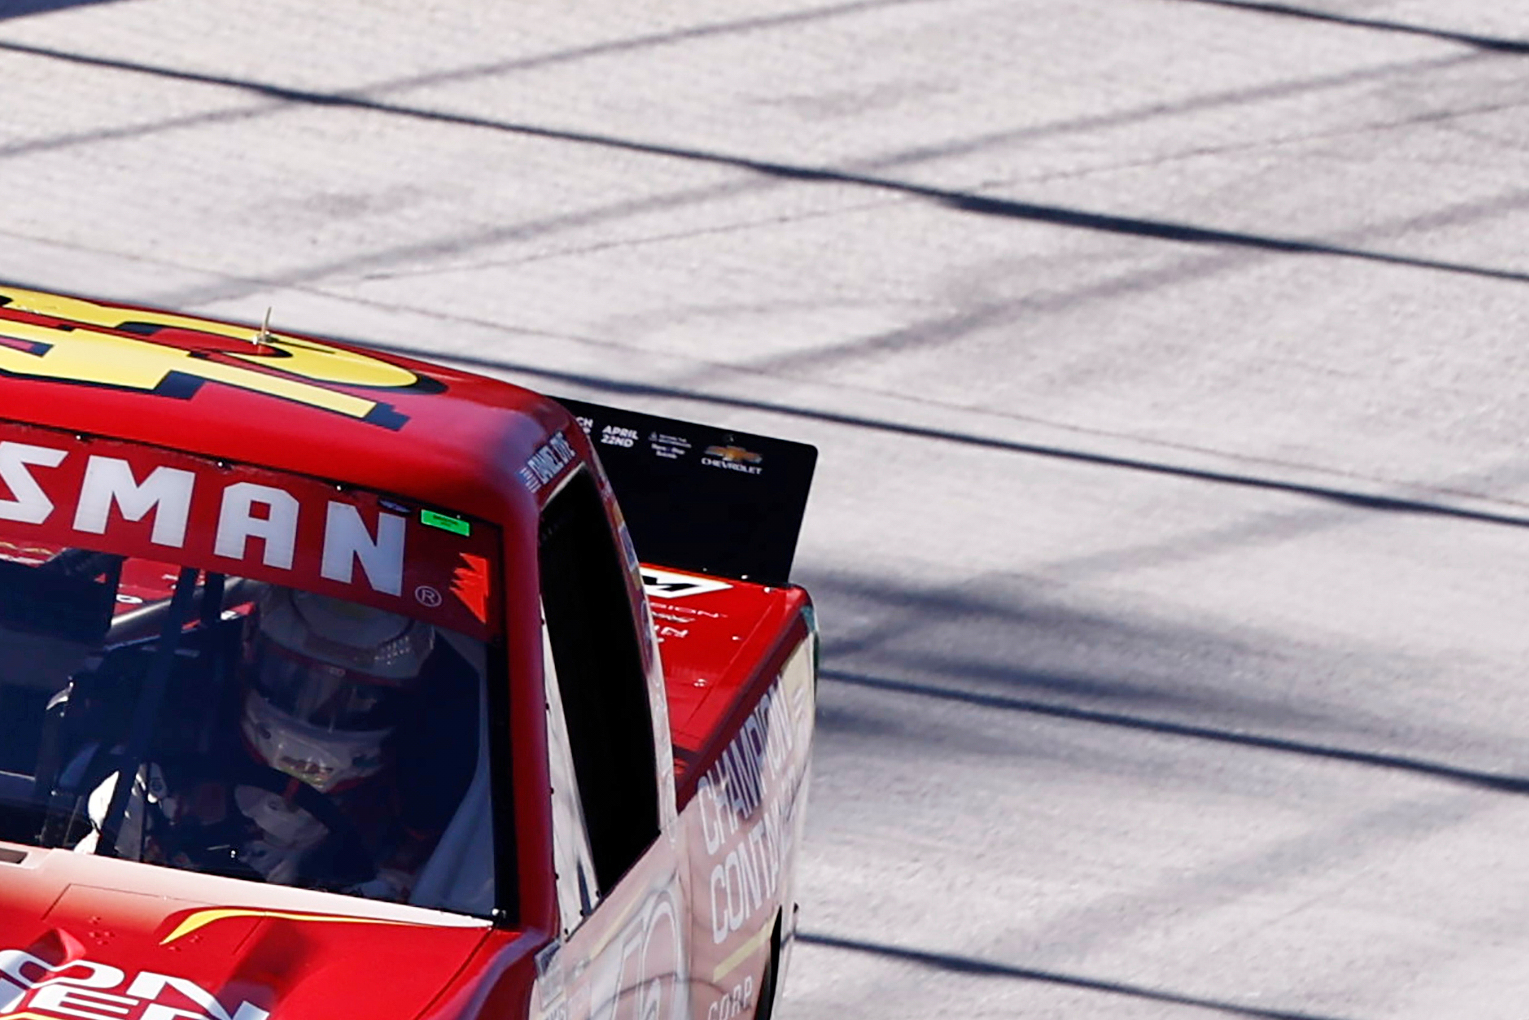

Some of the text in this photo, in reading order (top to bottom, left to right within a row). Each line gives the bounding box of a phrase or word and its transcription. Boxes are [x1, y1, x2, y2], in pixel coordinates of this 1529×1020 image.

[602, 425, 638, 440] APRIL
[601, 434, 634, 448] 22ND
[701, 457, 762, 475] CHEVROLET
[697, 674, 793, 856] CHAMPION
